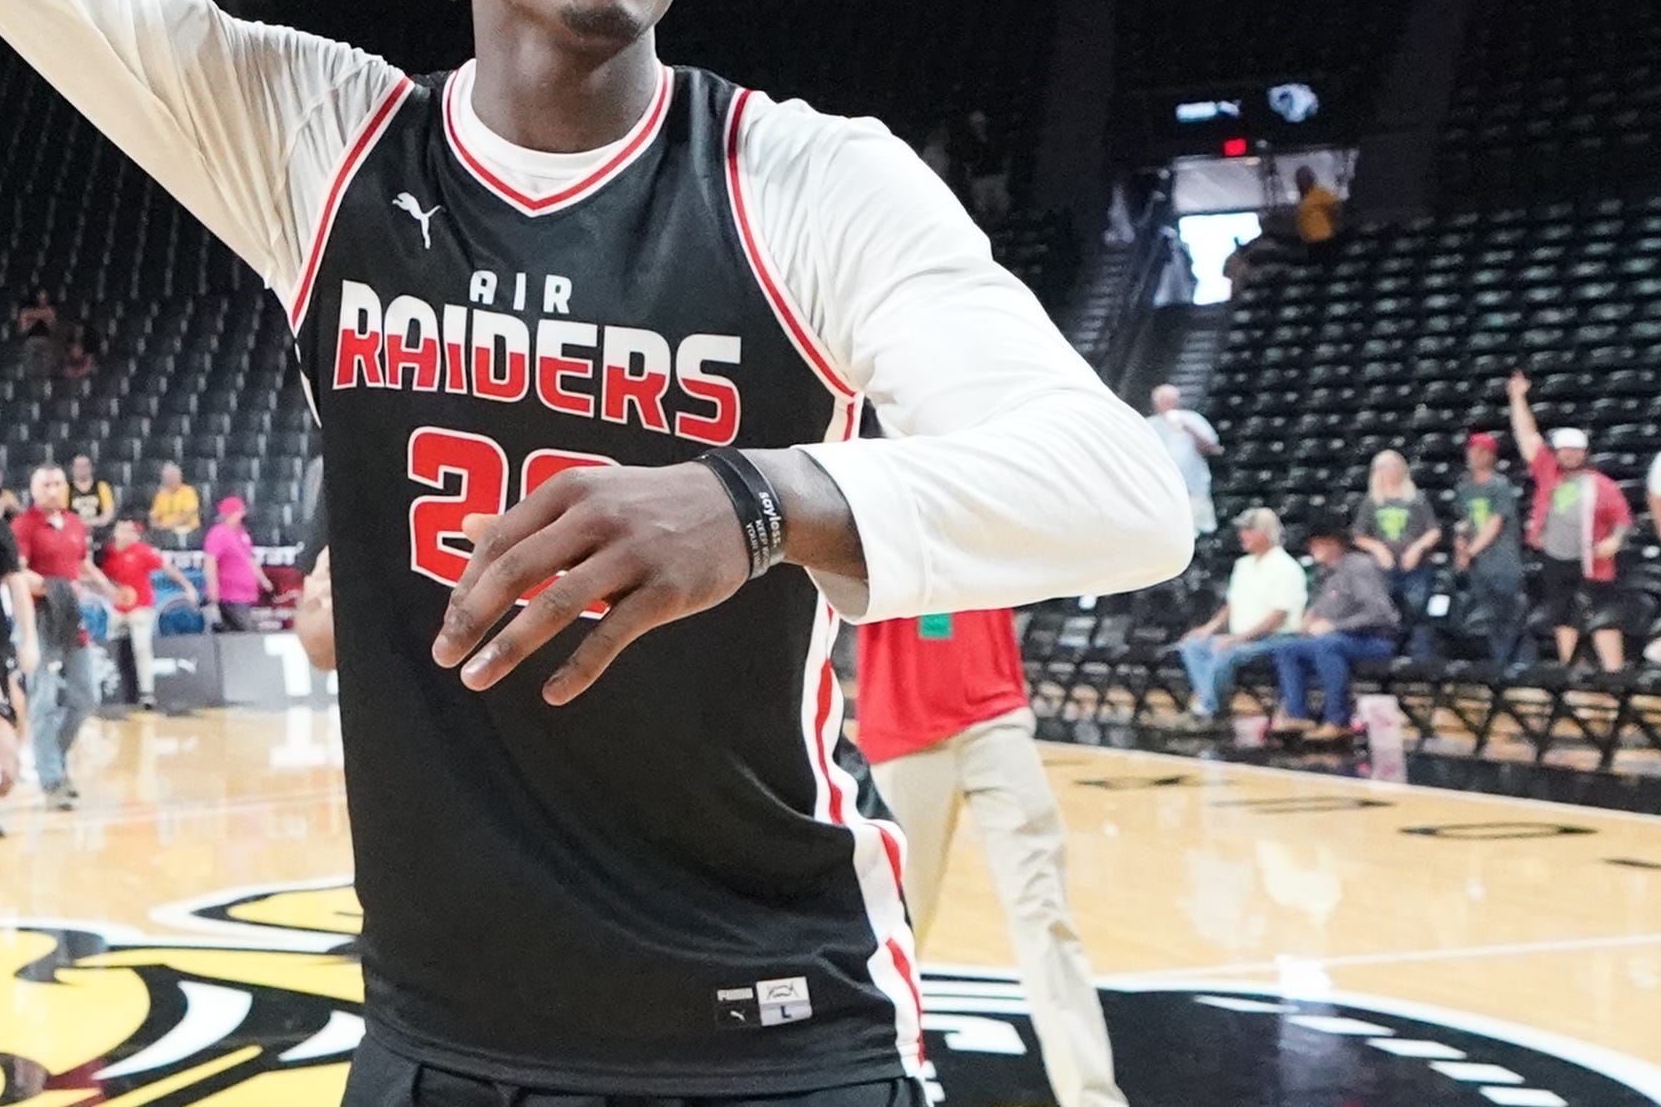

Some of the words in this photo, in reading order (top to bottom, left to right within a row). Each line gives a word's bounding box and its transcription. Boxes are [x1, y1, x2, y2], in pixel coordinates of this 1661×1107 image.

[469, 270, 572, 314] AIR
[332, 279, 741, 446] RAIDERS
[780, 1005, 792, 1019] L
